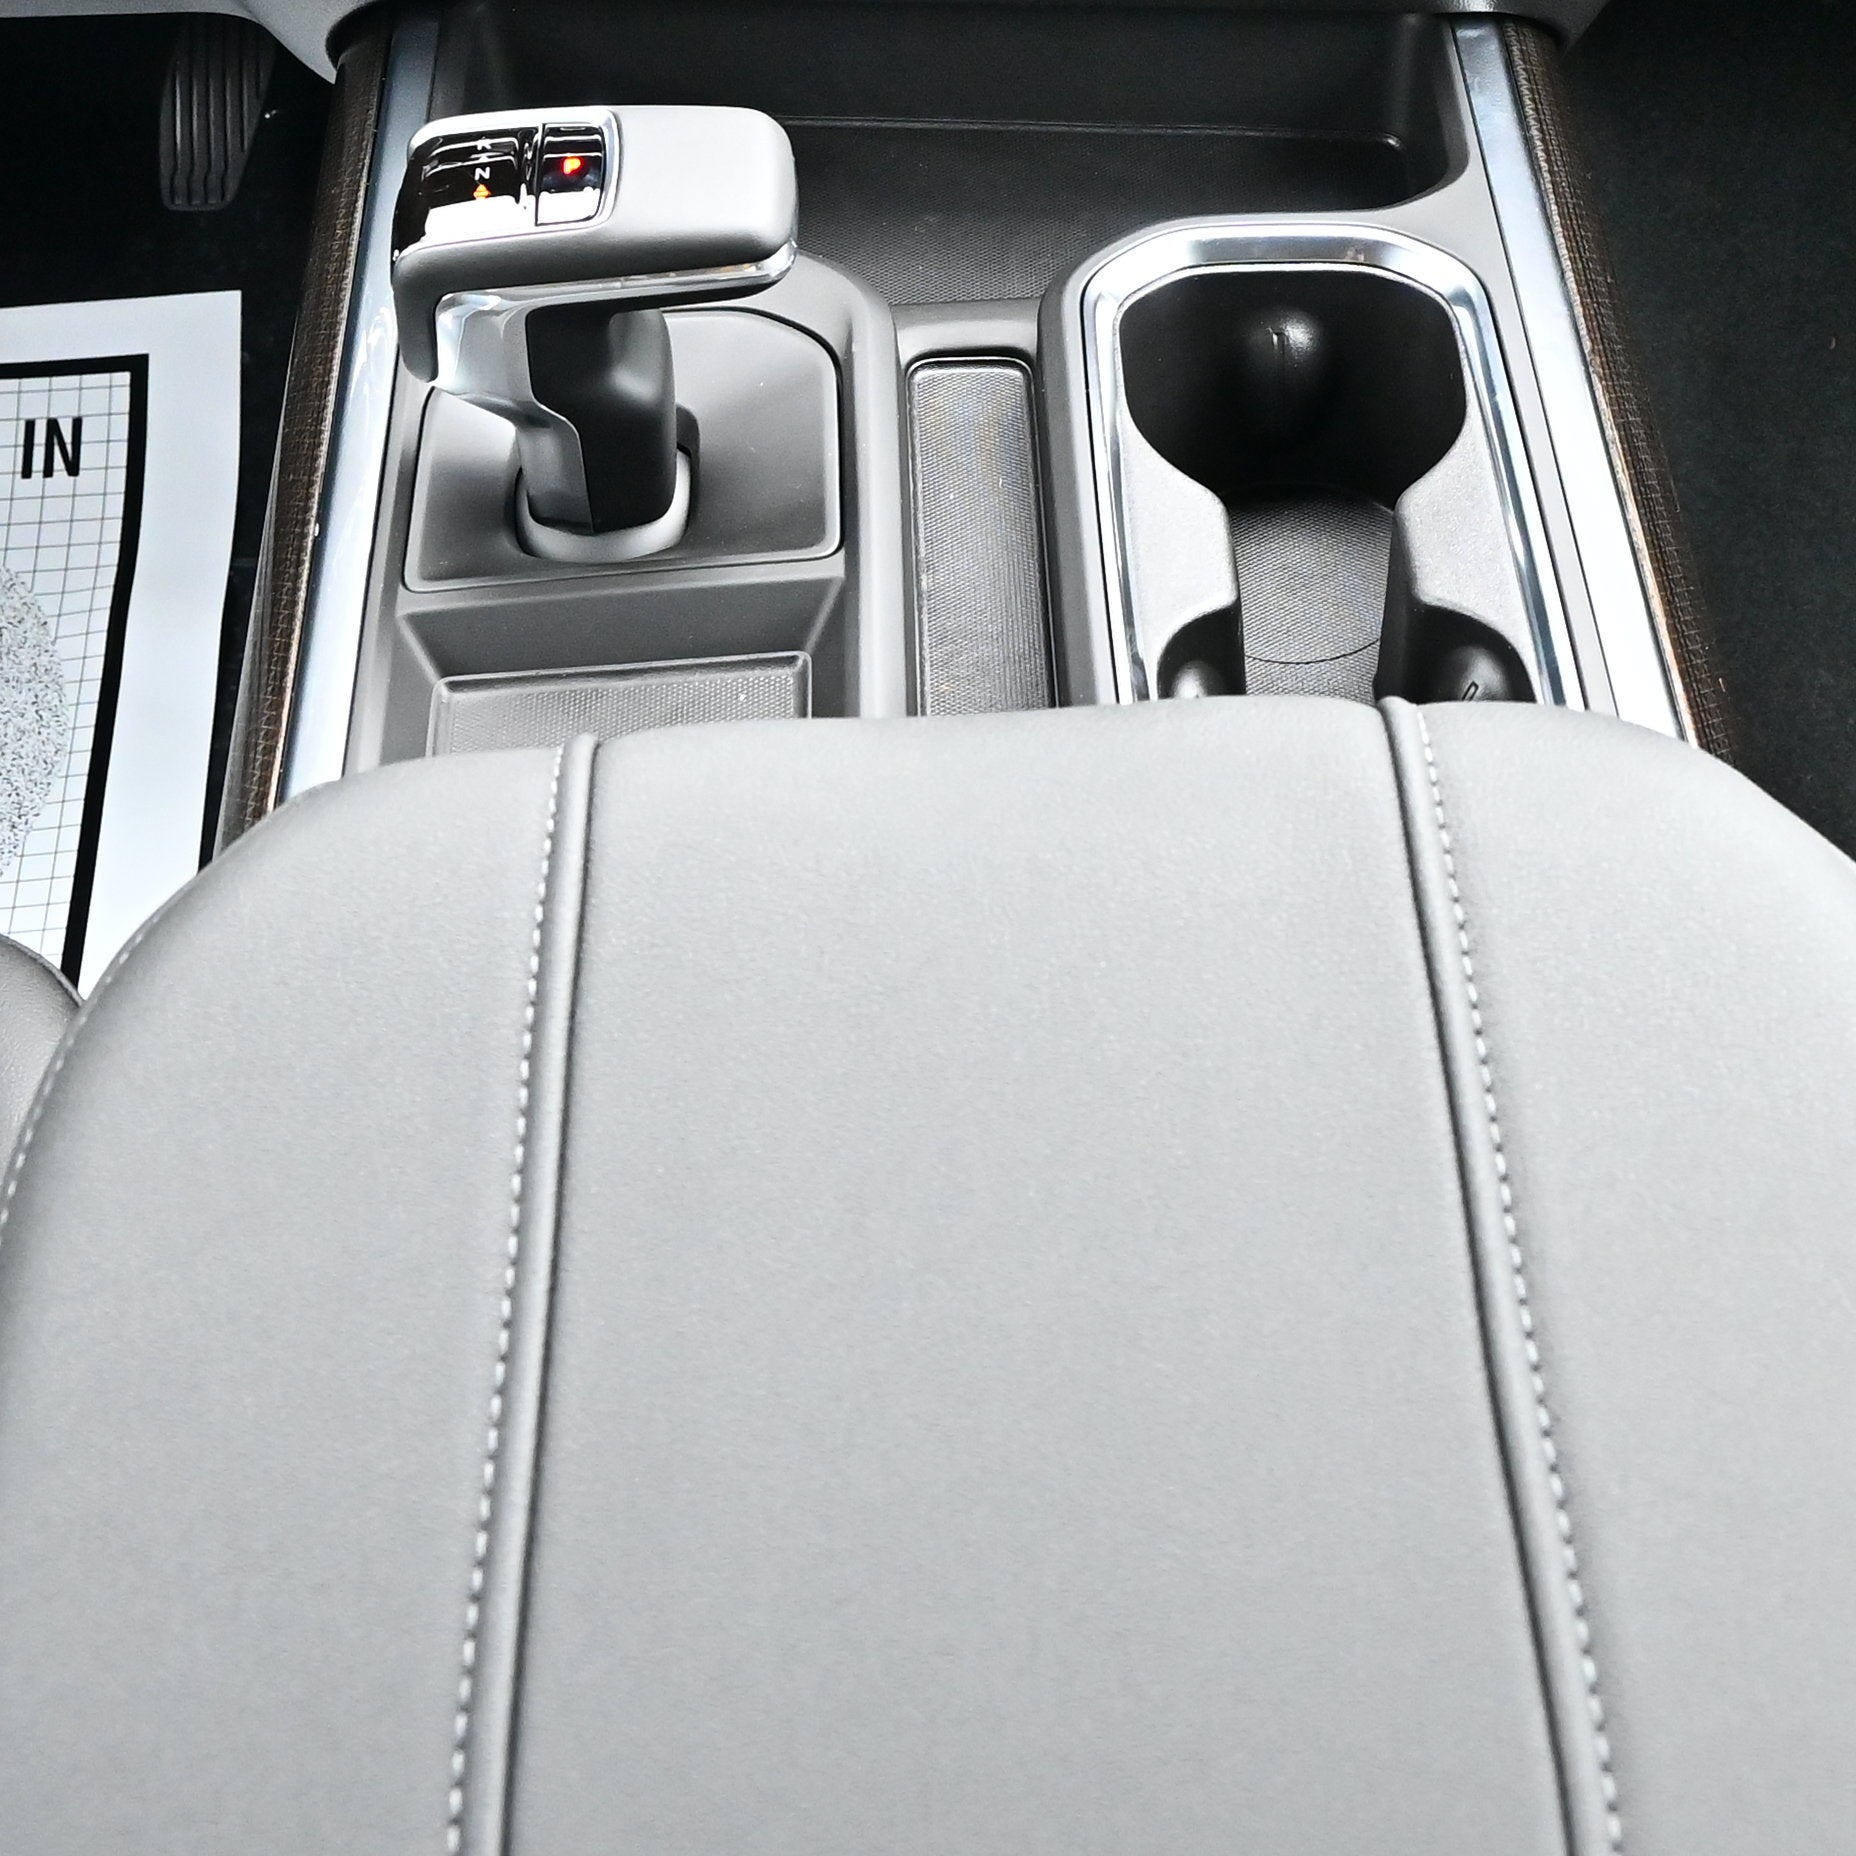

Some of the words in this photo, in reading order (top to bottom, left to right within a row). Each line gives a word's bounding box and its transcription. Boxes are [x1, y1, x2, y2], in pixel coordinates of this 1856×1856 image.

[474, 166, 491, 181] N
[563, 156, 582, 175] P
[20, 416, 83, 480] IN
